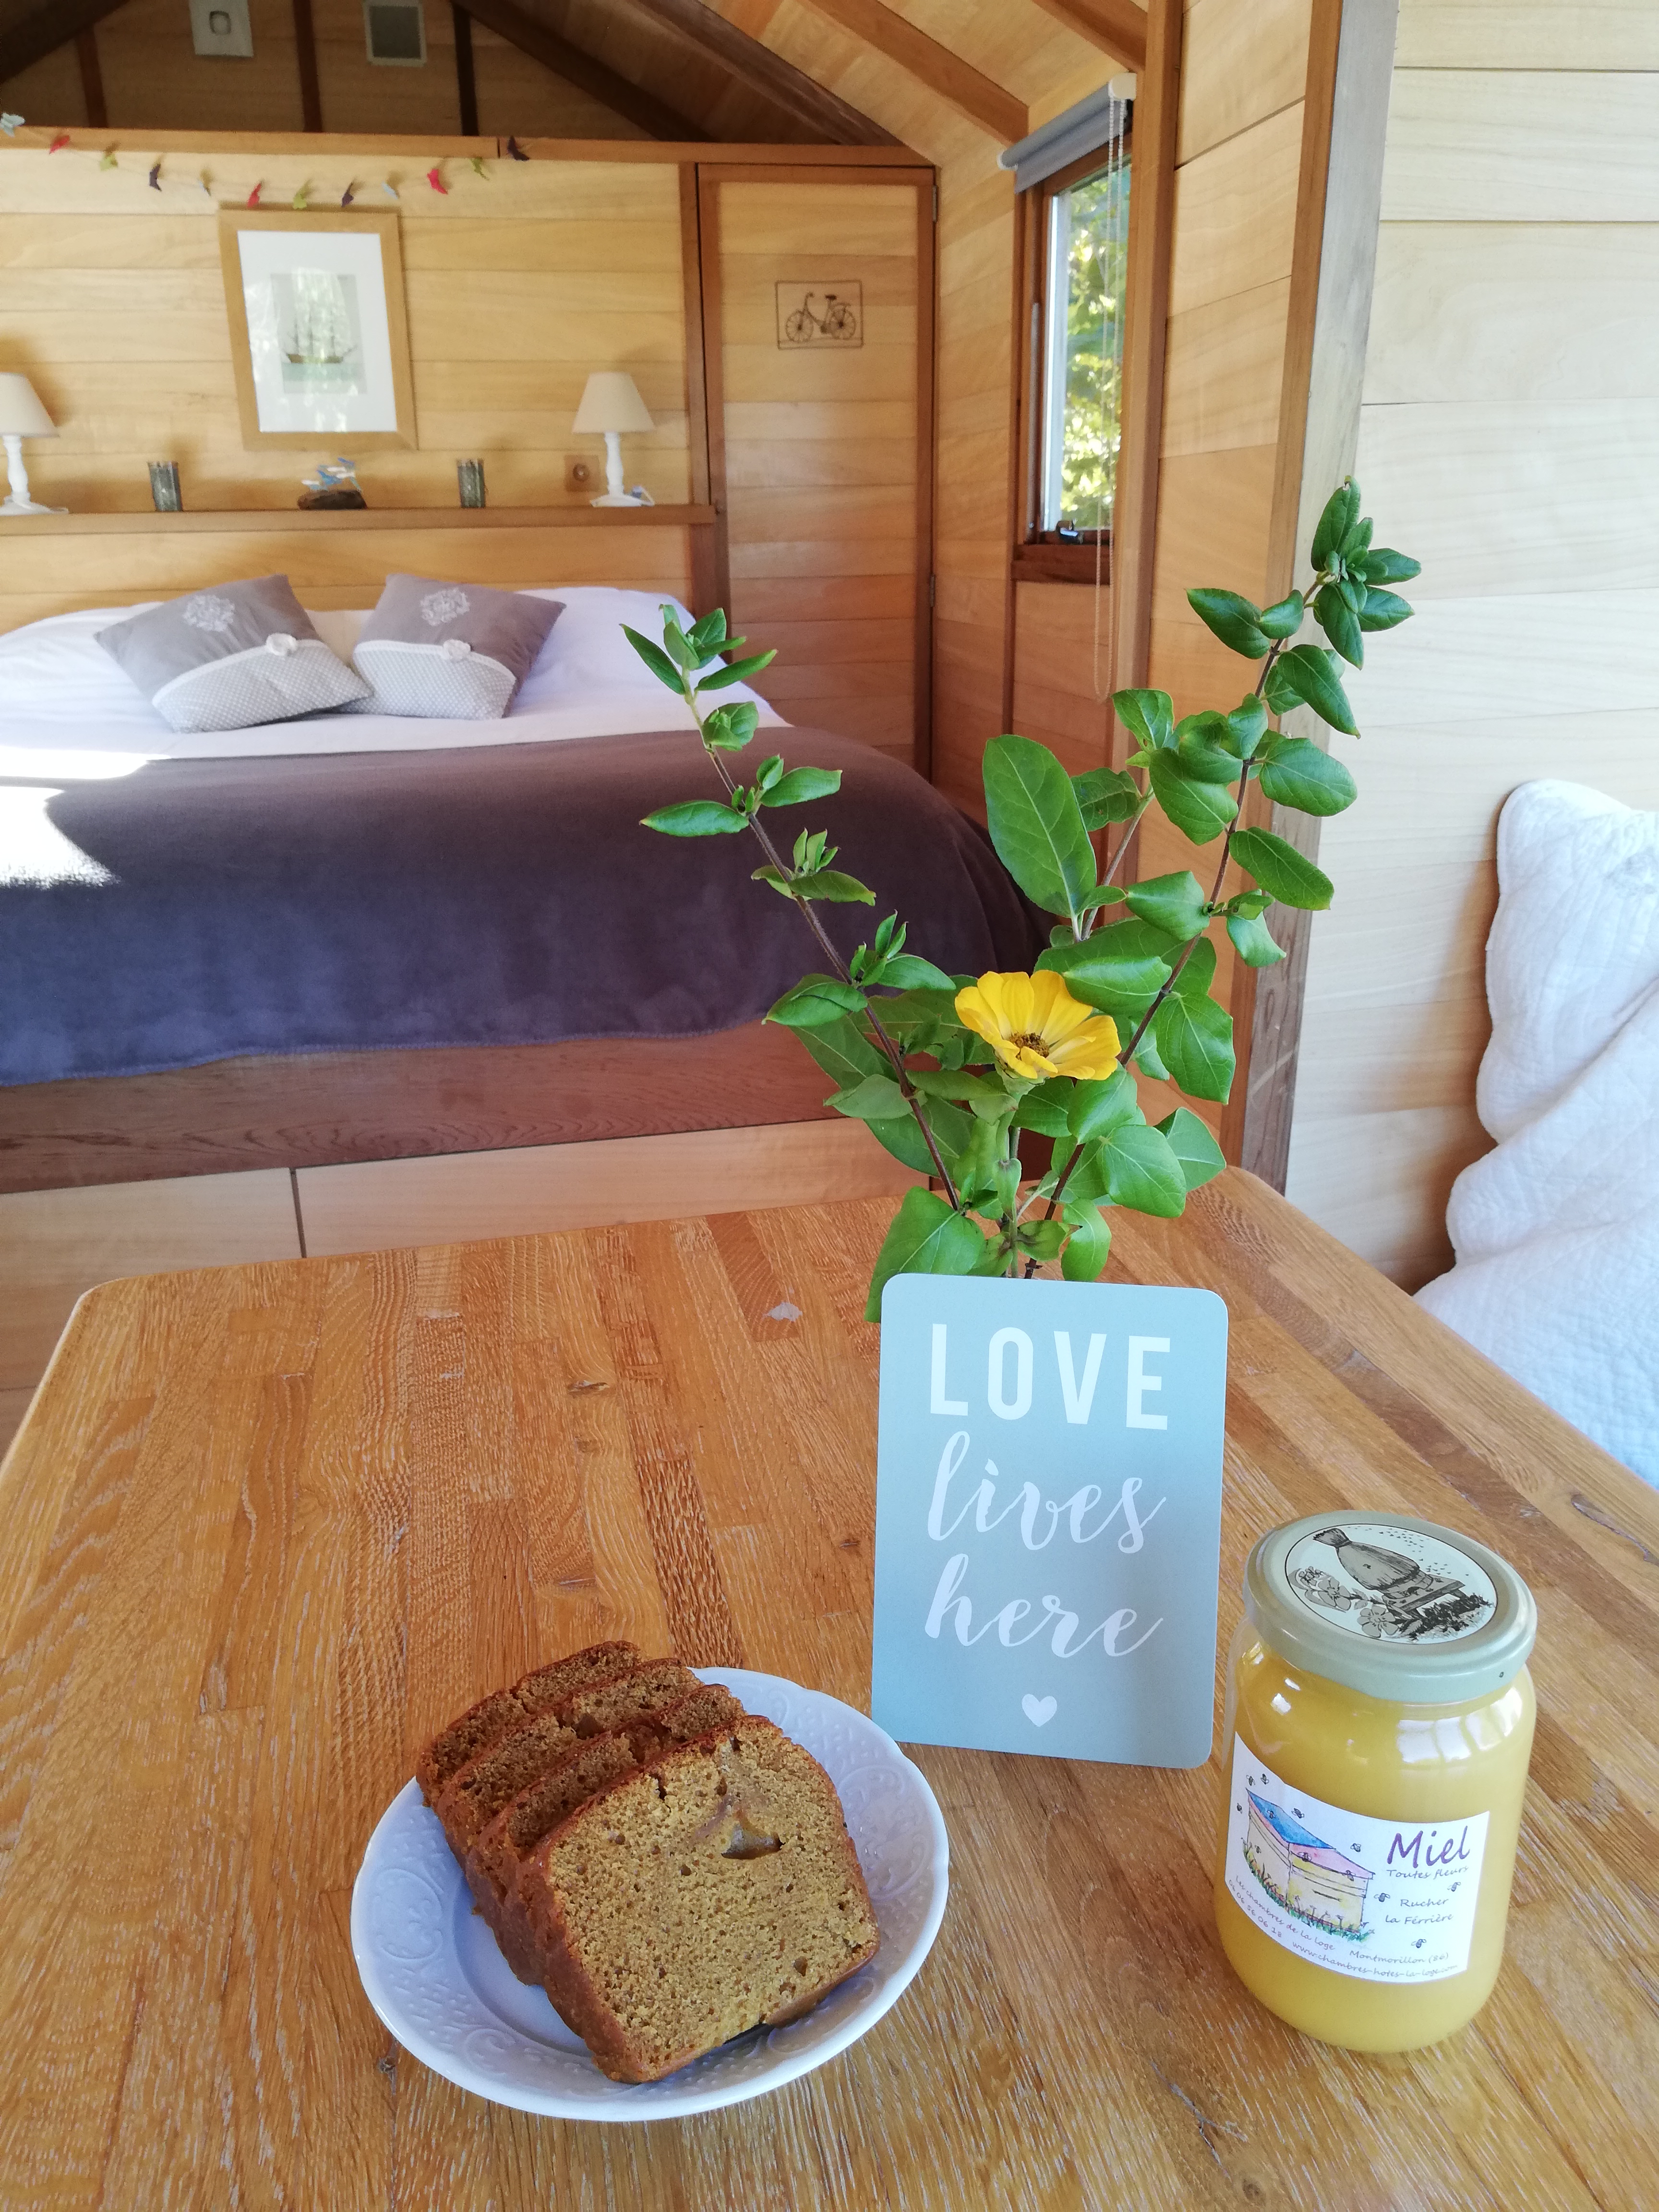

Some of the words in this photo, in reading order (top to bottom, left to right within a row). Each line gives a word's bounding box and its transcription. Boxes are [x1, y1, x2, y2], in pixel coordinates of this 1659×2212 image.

[930, 1323, 1170, 1430] LOVE
[927, 1431, 1166, 1553] lives
[925, 1553, 1163, 1658] here
[1387, 1825, 1470, 1868] Miel
[1386, 1870, 1431, 1878] Toutes
[1433, 1865, 1469, 1880] fleurs
[1237, 1892, 1245, 1904] 06
[1258, 1916, 1268, 1927] 06
[1385, 1914, 1400, 1923] la
[1400, 1899, 1449, 1907] Rucher
[1246, 1890, 1285, 1924] chambres
[1286, 1923, 1298, 1933] de
[1300, 1930, 1312, 1940] la
[1314, 1937, 1335, 1950] loge
[1349, 1950, 1425, 1963] Montmorillon
